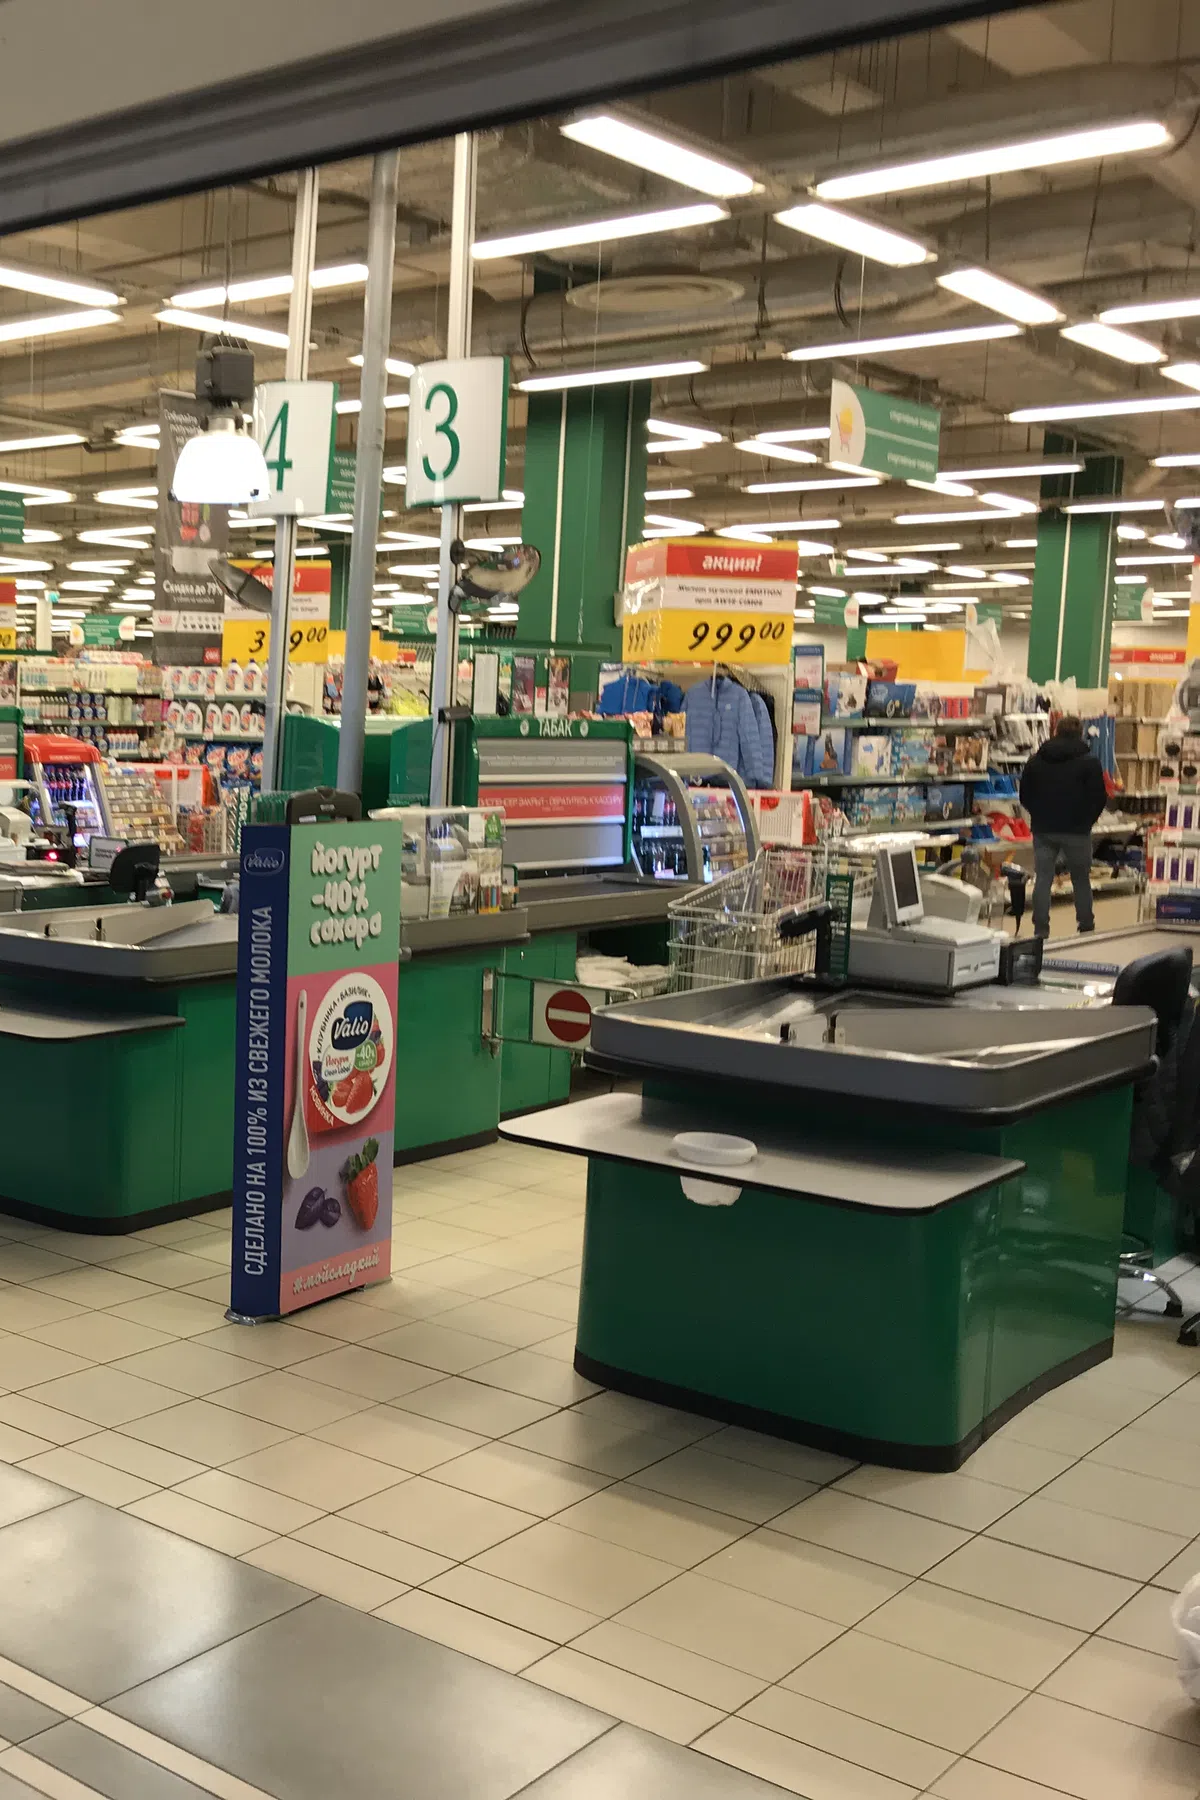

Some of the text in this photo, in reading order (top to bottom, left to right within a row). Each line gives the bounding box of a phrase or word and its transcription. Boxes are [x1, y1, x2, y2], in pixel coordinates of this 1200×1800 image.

[263, 399, 293, 492] 4
[422, 383, 460, 482] 3
[702, 553, 763, 574] акция!
[537, 718, 573, 737] ТАБАК
[311, 880, 369, 914] -40%
[310, 911, 382, 949] сахара
[333, 1015, 369, 1041] Valio
[244, 905, 272, 1276] СДЕЛАНО НА 100% ИЗ СВЕЖЕГО МОЛОКА
[309, 1086, 335, 1127] НОВИНКА
[292, 1247, 381, 1296] #мойсладкий
